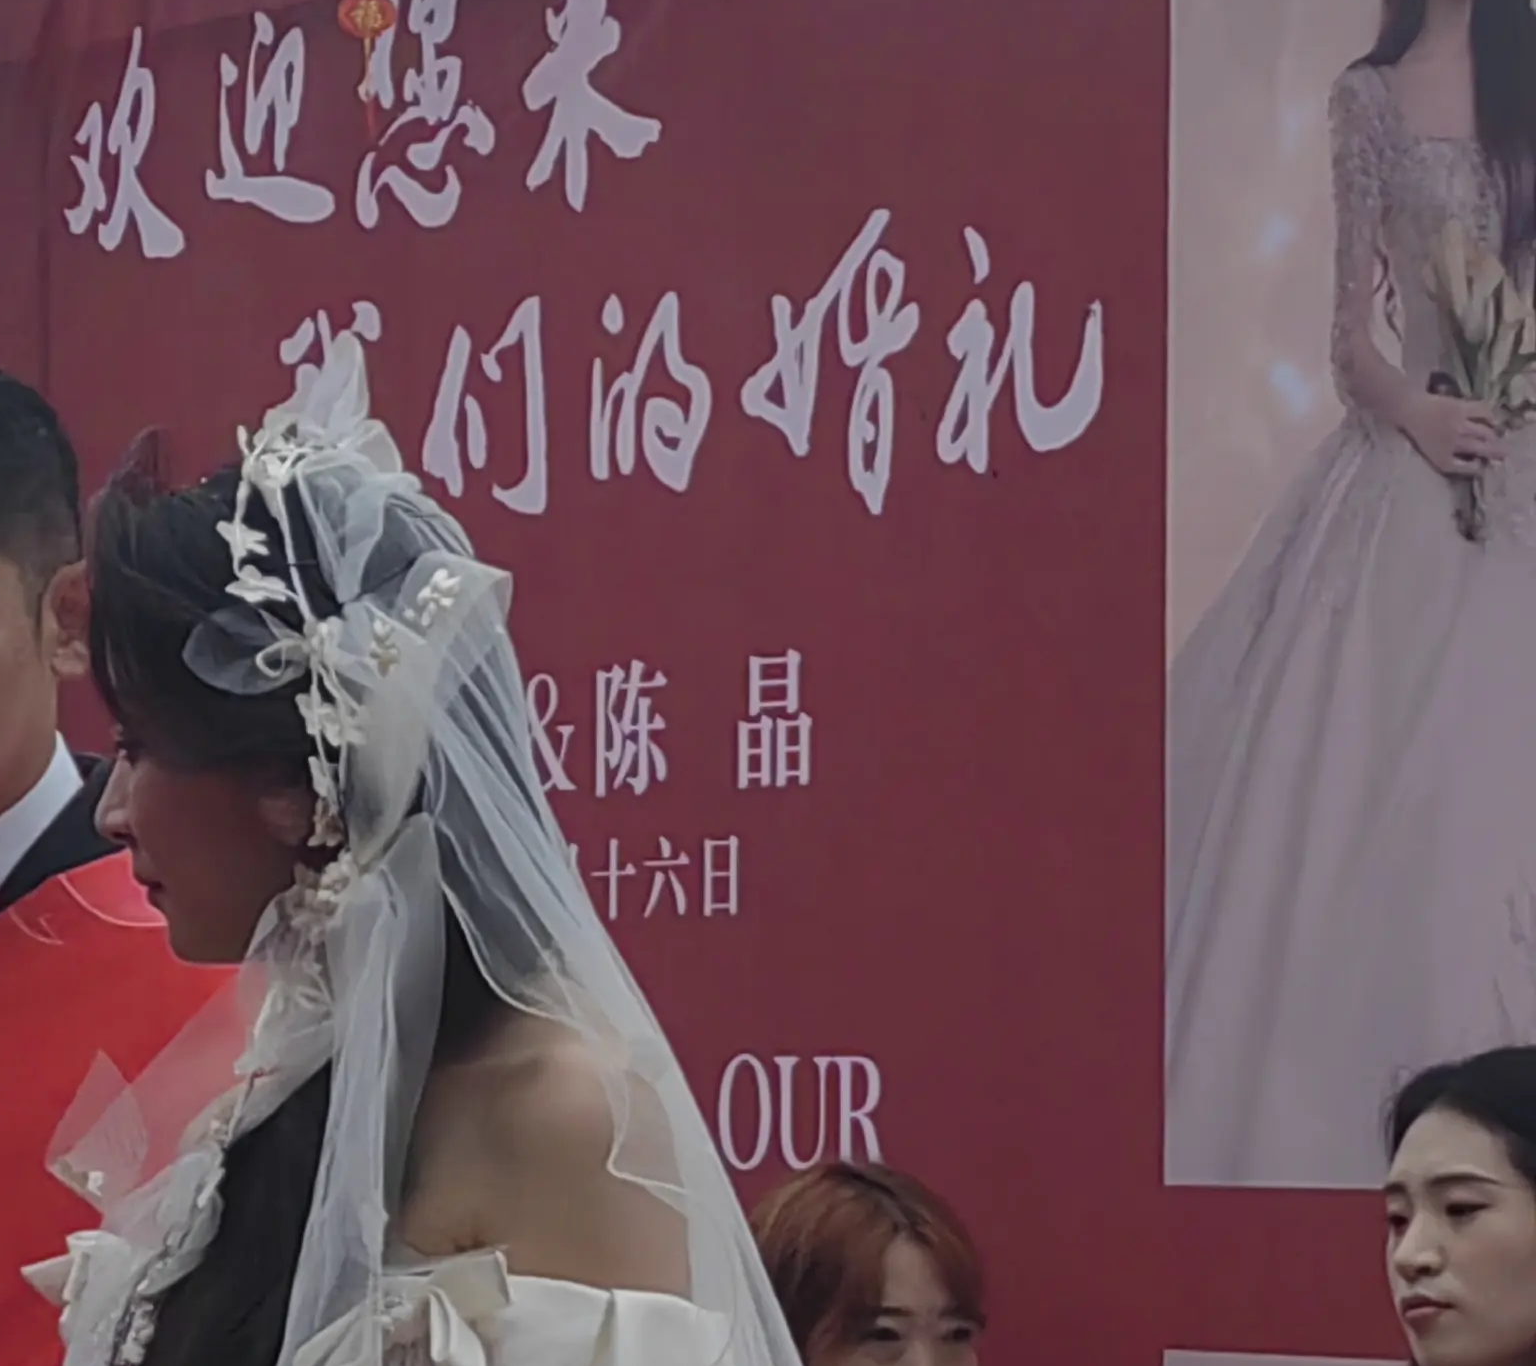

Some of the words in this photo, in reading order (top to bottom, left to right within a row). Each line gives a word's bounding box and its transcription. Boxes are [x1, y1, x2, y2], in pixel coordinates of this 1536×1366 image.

[568, 834, 740, 921] 十六日
[717, 1052, 883, 1171] OUR
